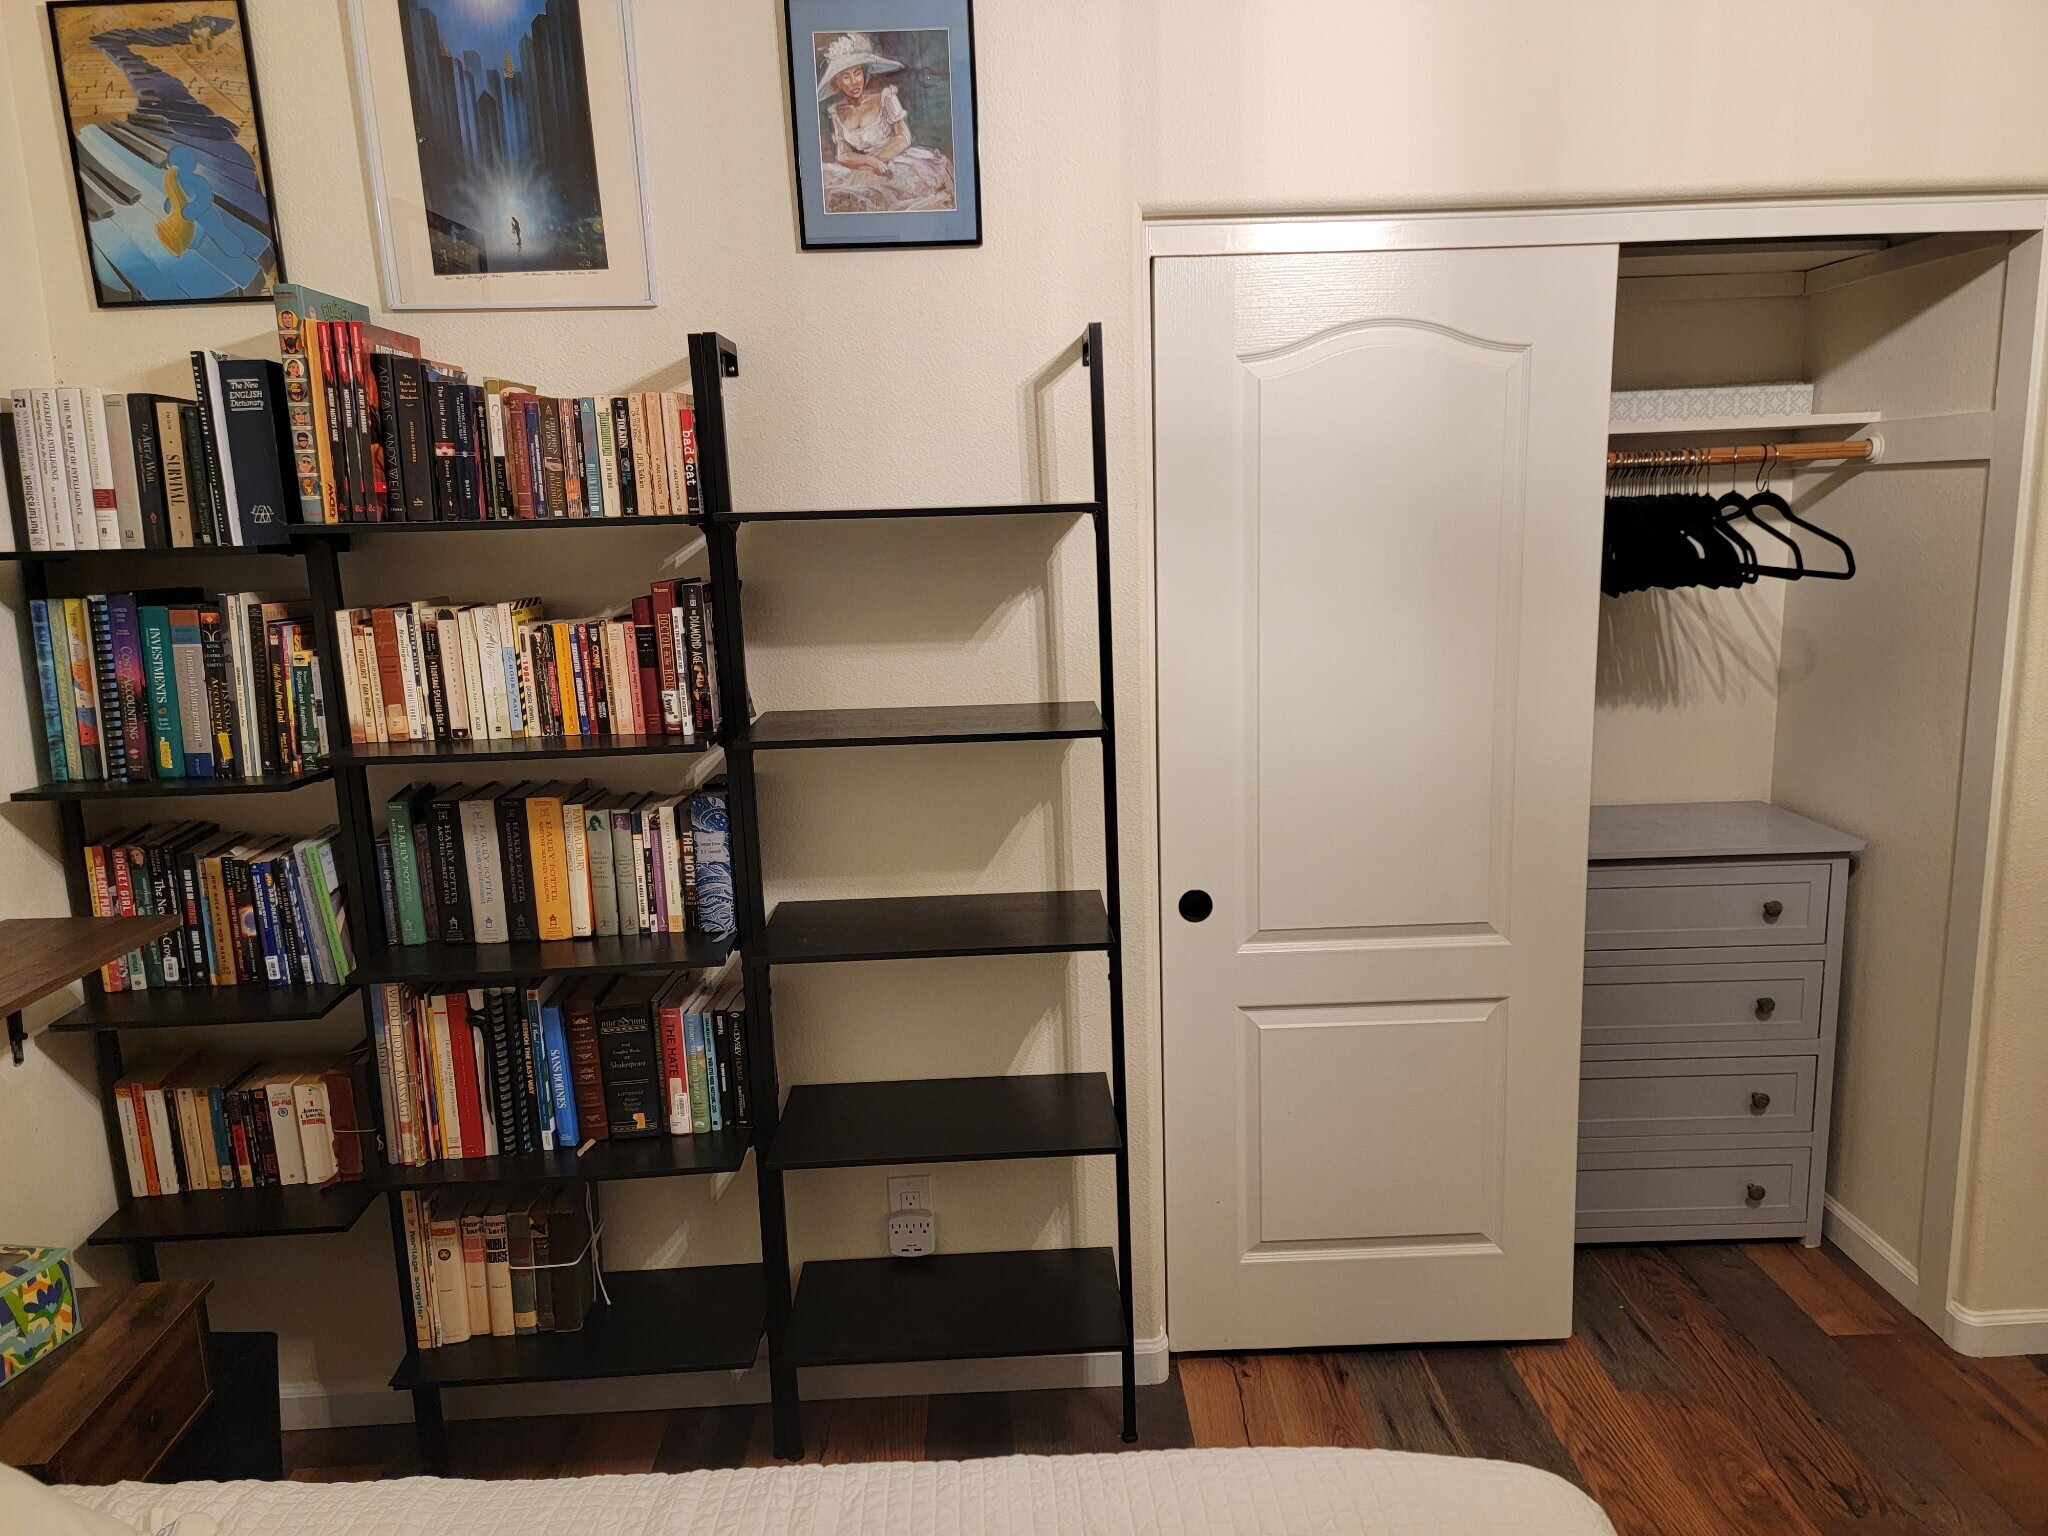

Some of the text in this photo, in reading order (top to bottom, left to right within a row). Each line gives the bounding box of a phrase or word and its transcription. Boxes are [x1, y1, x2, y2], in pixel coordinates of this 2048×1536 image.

[229, 390, 262, 399] ENGLISH
[230, 381, 259, 389] The New
[230, 399, 264, 408] Dictionary
[438, 400, 446, 415] Little
[65, 414, 73, 429] NEW
[440, 418, 448, 439] Friend
[544, 420, 551, 430] OF
[618, 418, 629, 448] TOLKIEN
[42, 392, 59, 481] PEACEKEEPING INTELLIGENCE
[66, 432, 76, 453] CRAFT
[141, 434, 153, 453] ART
[549, 417, 558, 455] CHILDREN
[70, 456, 77, 465] OF
[682, 429, 697, 486] bad cat
[145, 462, 155, 482] WAR
[165, 455, 185, 506] SURVIVAL
[25, 475, 39, 534] NurtureShock
[71, 467, 83, 516] INTELLIGENCE
[549, 473, 558, 508] HERBERT
[555, 476, 563, 505] FRANK
[69, 612, 77, 628] 1996
[660, 613, 670, 649] DOCTOR
[71, 641, 81, 662] Joseph
[358, 648, 367, 679] MYTHOLOGY
[398, 629, 408, 673] Hemingway
[591, 645, 601, 668] CONAN
[74, 664, 84, 679] High
[150, 627, 167, 704] INVESTMENTS
[430, 665, 439, 689] THOUSAND
[522, 660, 530, 682] 1984
[77, 681, 86, 701] School
[120, 646, 138, 740] COST ACCOUNTING
[185, 650, 203, 741] Financial Management
[211, 677, 223, 732] ACCOUNTI
[433, 690, 442, 713] SPLENDID
[525, 685, 533, 704] GEORGE
[277, 710, 285, 723] Dad
[437, 714, 445, 726] SUNS
[571, 807, 585, 872] RAY BRADBURY
[397, 824, 412, 902] HARRY POTTER
[444, 824, 458, 904] HARRY POTTER
[479, 824, 493, 904] HARRY POTTER
[511, 821, 526, 903] HARRY POTTER
[545, 820, 558, 903] HARRY POTTER
[682, 830, 695, 886] THE MOTH
[114, 851, 131, 912] ROCKET GIRL
[154, 878, 165, 896] The
[183, 869, 191, 880] HOW
[443, 880, 449, 888] OF
[388, 988, 410, 1119] WHOLE BODY MASSAGE
[521, 1018, 530, 1045] FRENCH
[527, 1079, 535, 1095] WAY
[666, 1023, 679, 1076] THE HATE
[733, 1029, 742, 1057] ODYSSEY
[377, 1041, 389, 1076] MONET
[445, 1050, 453, 1070] Rolling
[610, 1061, 646, 1069] Shakespeare
[550, 1049, 566, 1109] SANS BORNES
[486, 1237, 507, 1250] NOBLE
[486, 1251, 508, 1263] HOUSE
[409, 1230, 424, 1320] heritage songster
